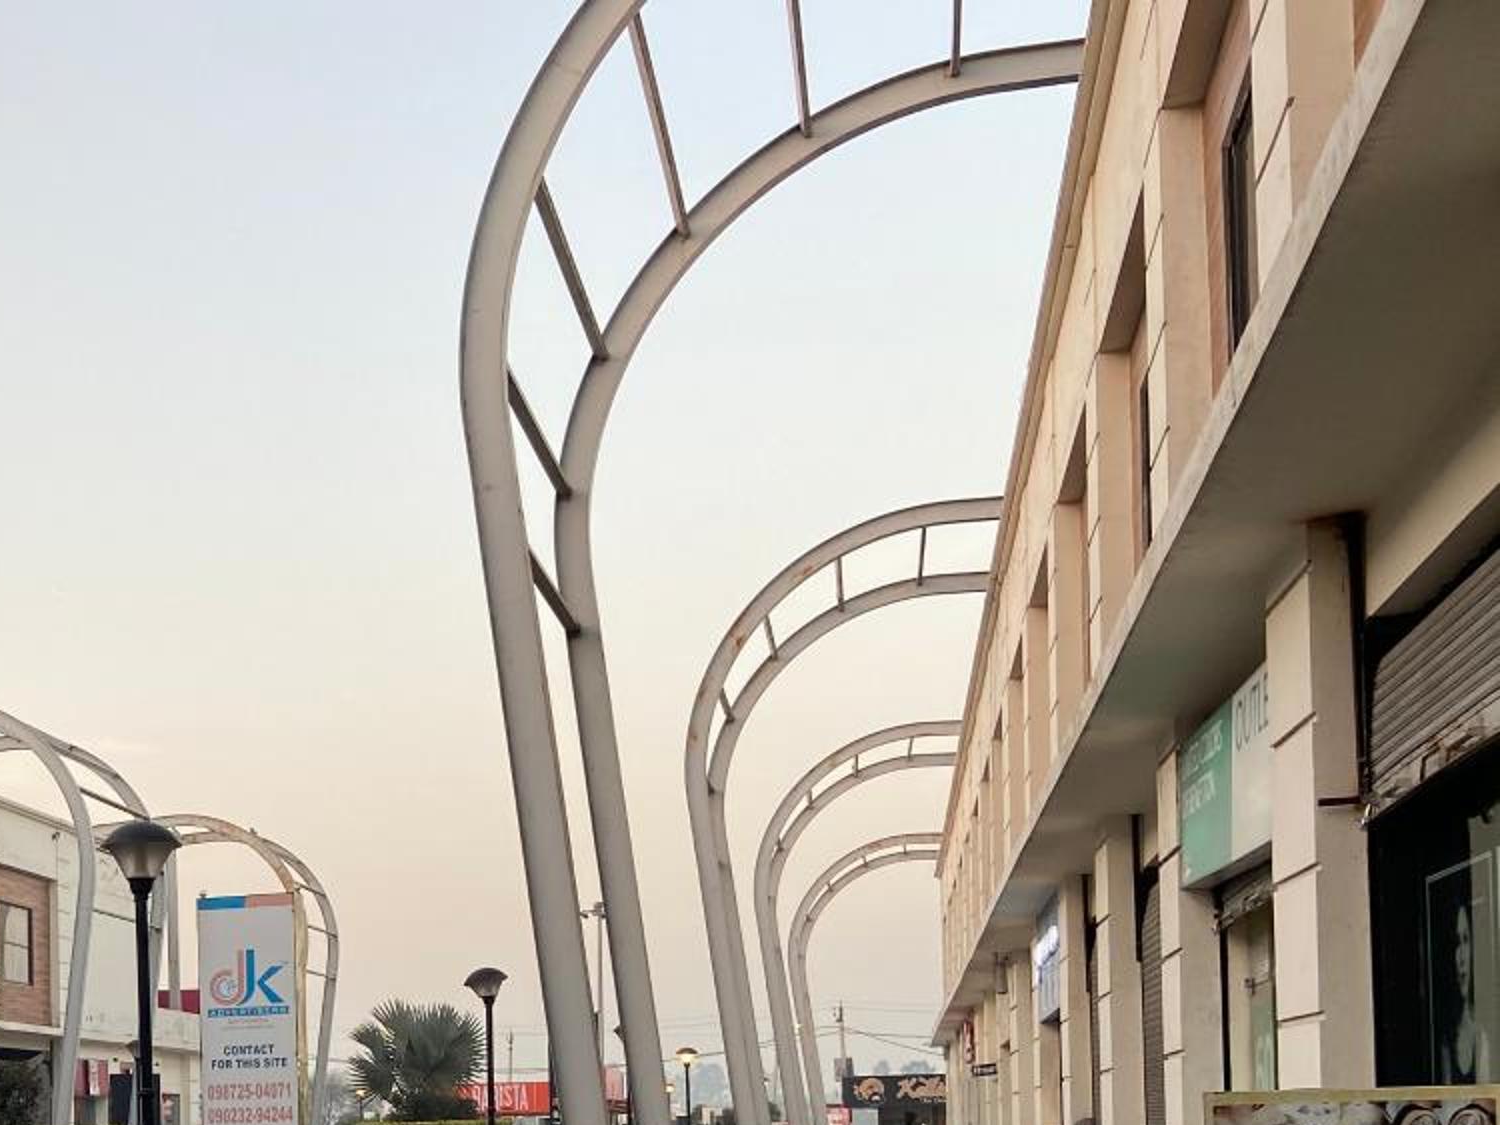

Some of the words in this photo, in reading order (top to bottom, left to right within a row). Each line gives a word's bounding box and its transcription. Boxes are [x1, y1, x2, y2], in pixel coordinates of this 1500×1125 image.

[1234, 671, 1270, 751] OUTLE
[223, 1043, 274, 1057] CONTACT
[211, 1058, 233, 1071] FOR
[236, 1058, 261, 1069] THIS
[263, 1057, 288, 1069] SITE
